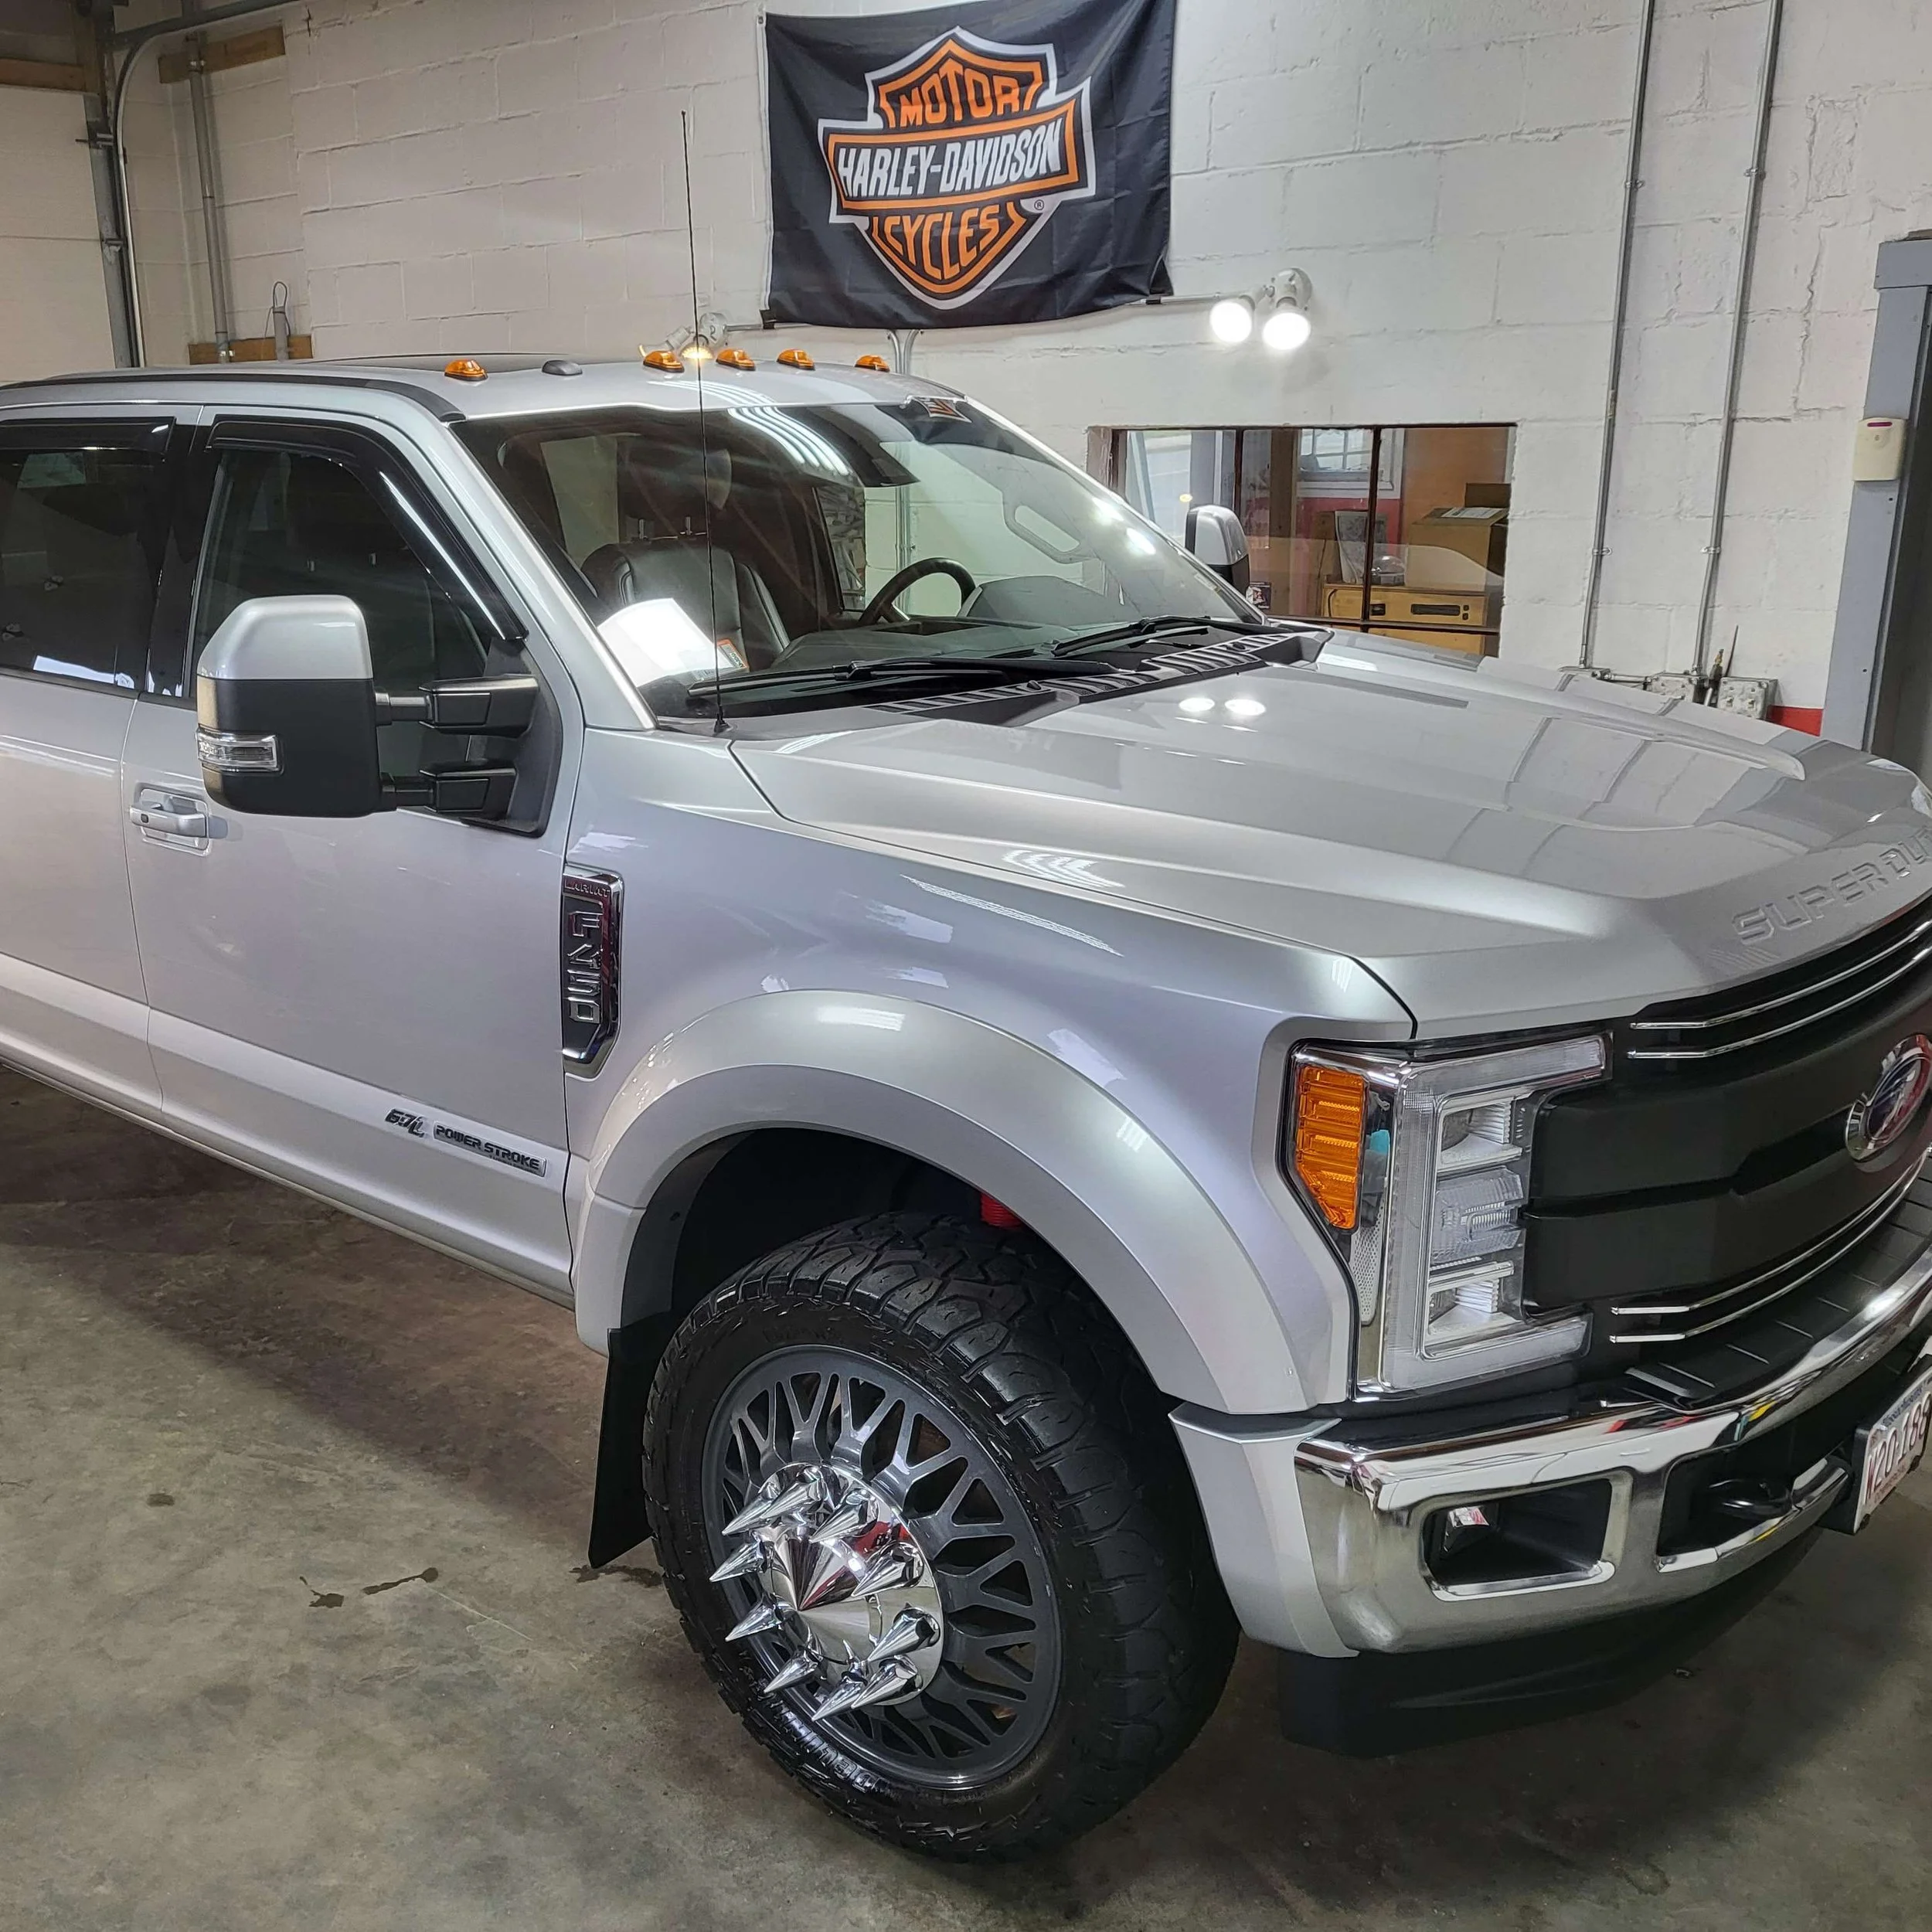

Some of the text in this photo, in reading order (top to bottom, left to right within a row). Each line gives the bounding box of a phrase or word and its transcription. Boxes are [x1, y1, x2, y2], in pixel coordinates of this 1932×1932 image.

[900, 58, 1020, 128] MOTOR
[837, 118, 1062, 198] HARLEY-DAVIDSON
[885, 202, 1002, 280] CYCLES
[1731, 862, 1889, 945] SUPER
[435, 1124, 482, 1150] POWER
[484, 1141, 541, 1170] STROKE
